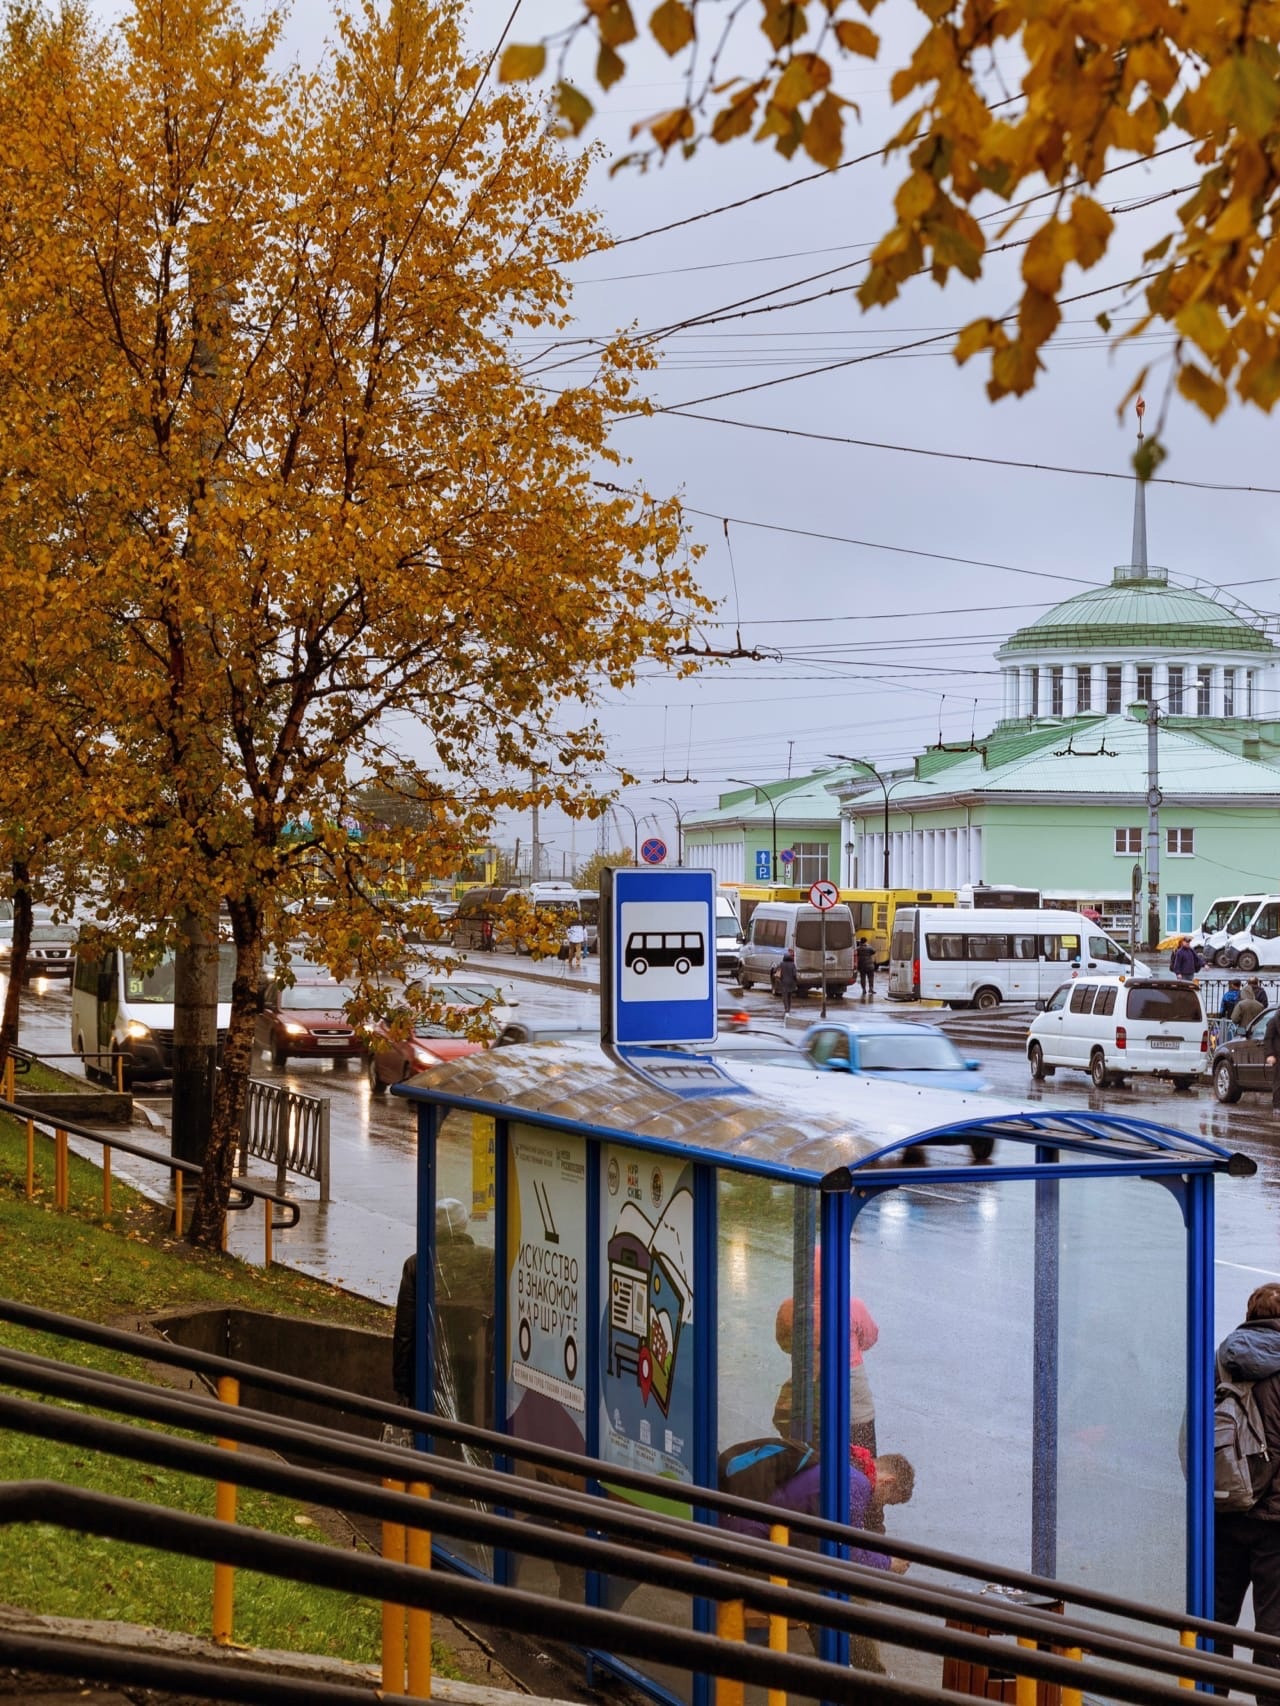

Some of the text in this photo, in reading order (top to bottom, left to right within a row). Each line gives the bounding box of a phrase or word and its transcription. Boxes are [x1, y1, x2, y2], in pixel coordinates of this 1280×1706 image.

[130, 980, 143, 993] 51
[518, 1240, 579, 1285] ИСКУССТВО
[517, 1270, 578, 1314] В ЗНАКОМОМ
[517, 1299, 578, 1338] МАРШРУТЕ
